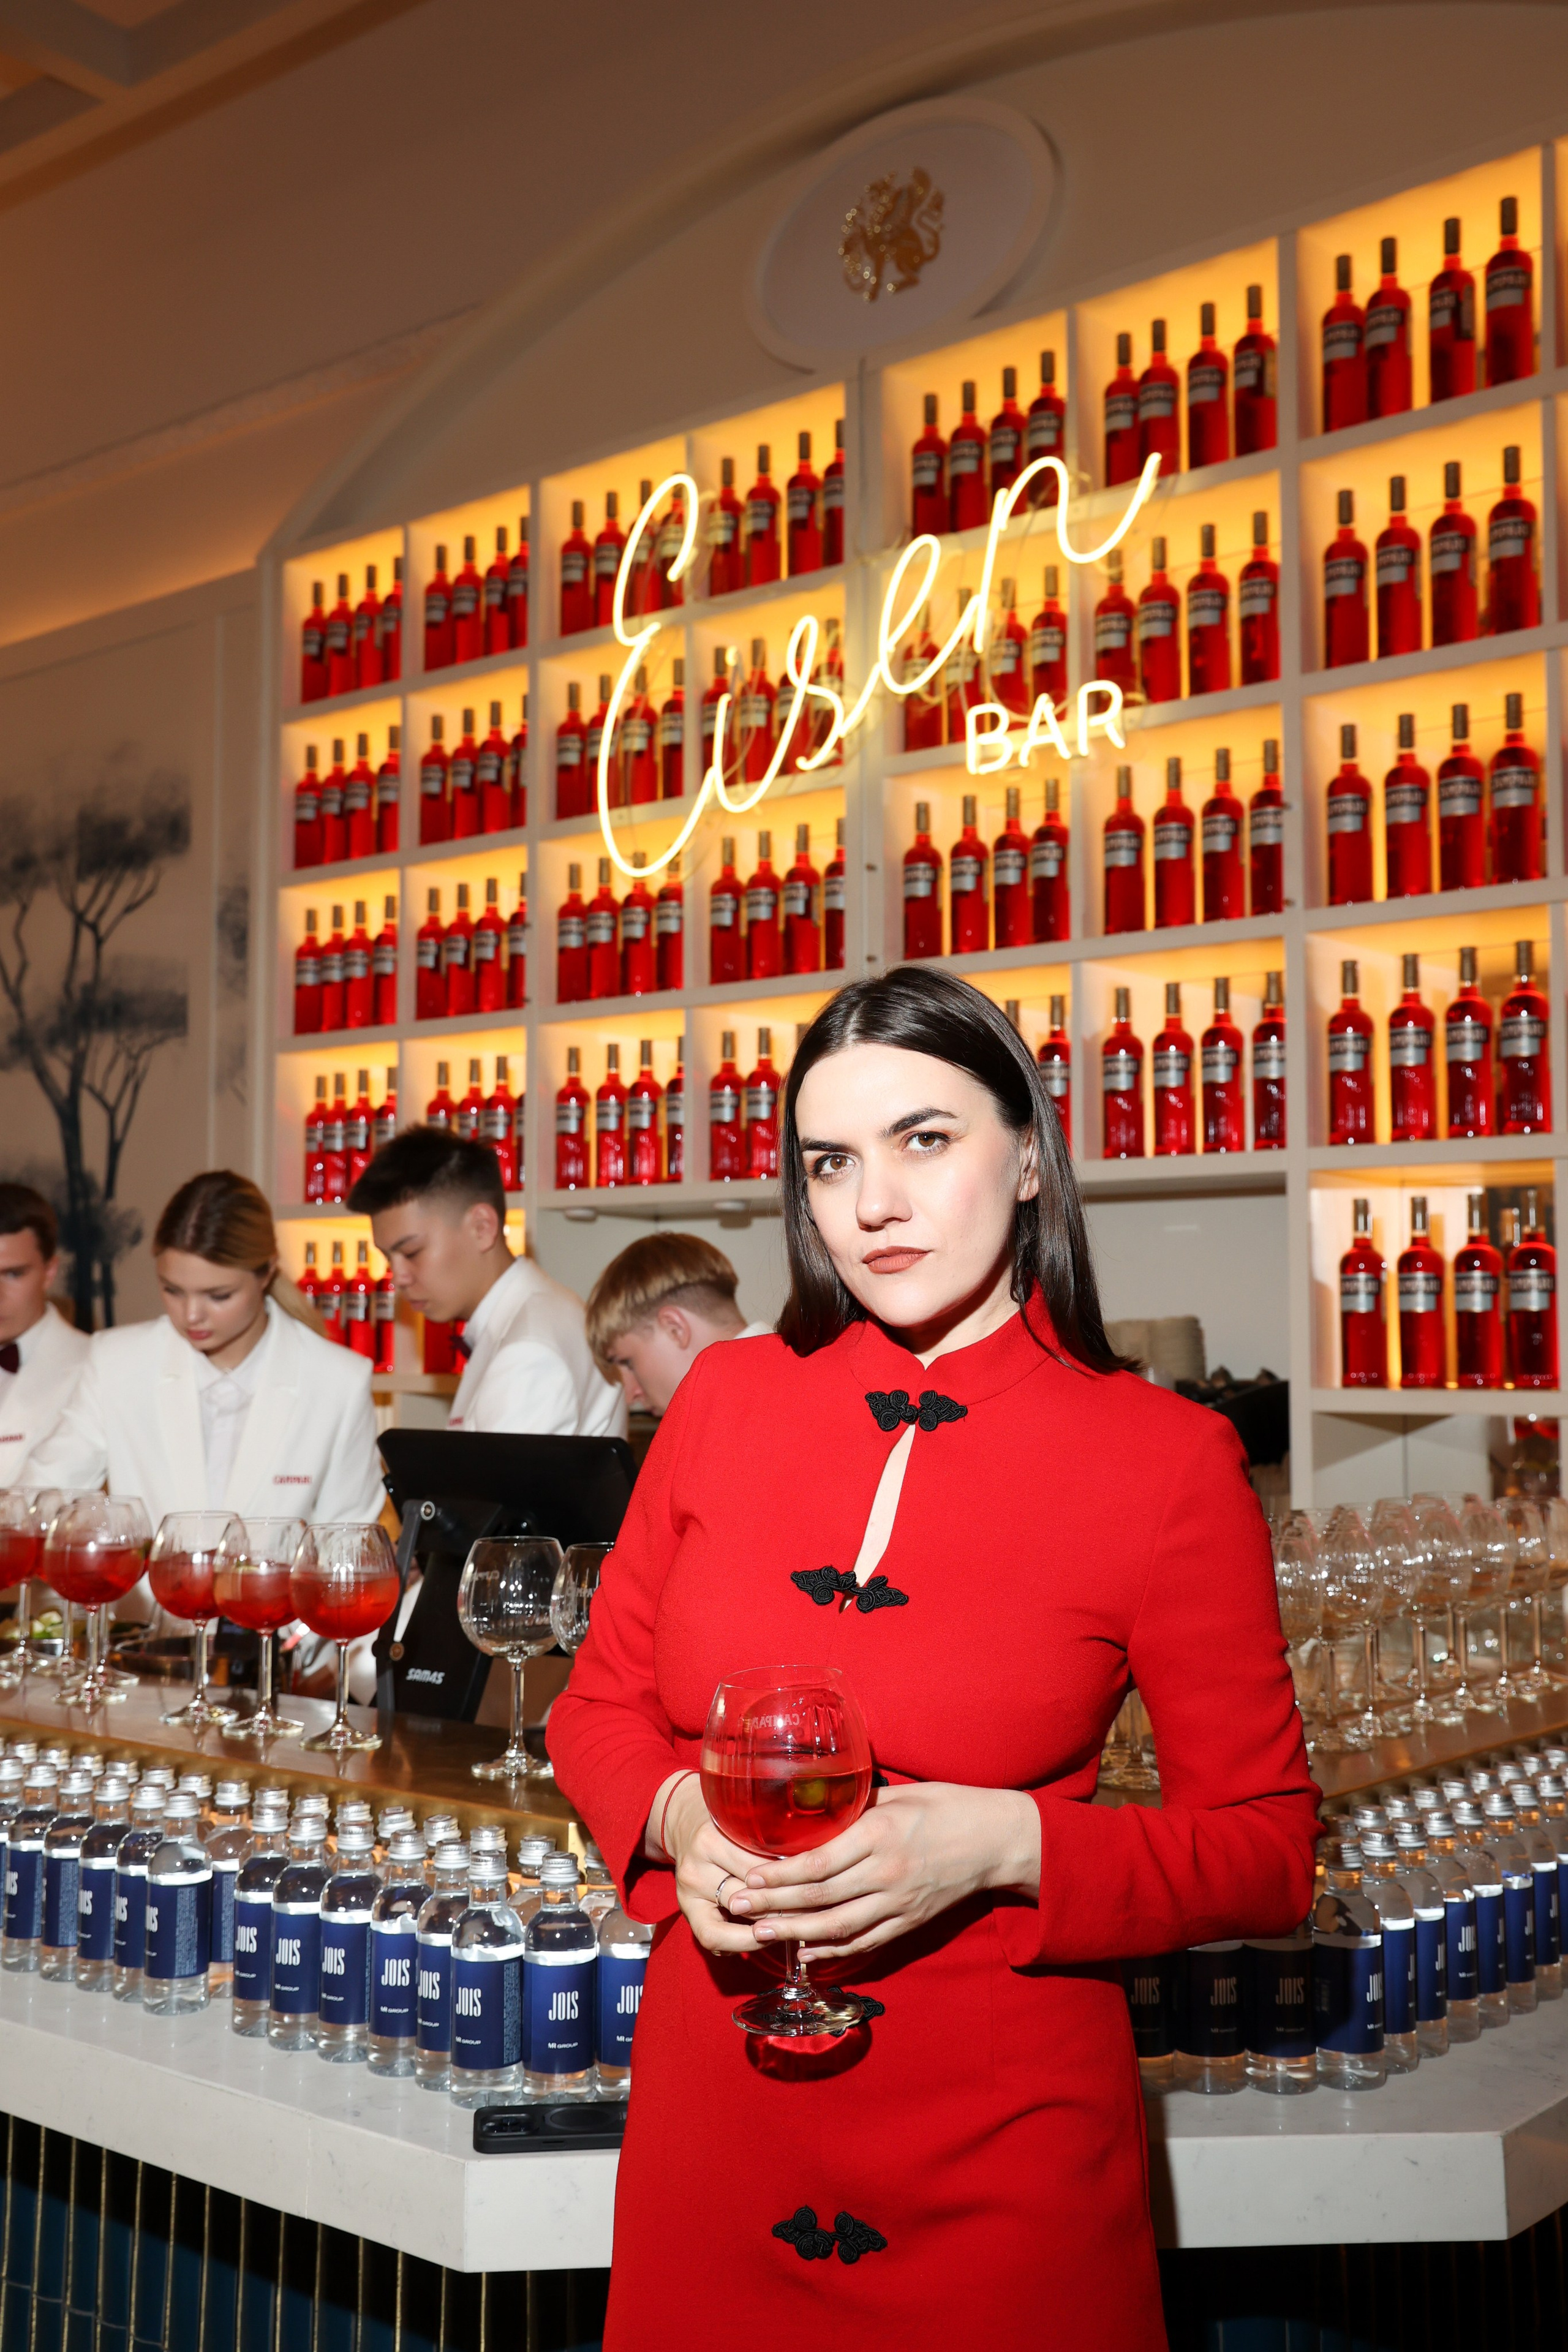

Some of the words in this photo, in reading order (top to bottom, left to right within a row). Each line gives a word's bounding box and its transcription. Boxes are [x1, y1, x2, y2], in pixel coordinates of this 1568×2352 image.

[966, 679, 1126, 774] BAR
[235, 1925, 257, 1953] JOIS
[276, 1937, 301, 1966] JOIS
[322, 1946, 345, 1975] JOIS
[381, 1958, 410, 1987] JOIS
[418, 1969, 440, 2000] JOIS
[1131, 1976, 1160, 2005] JOIS
[1210, 1976, 1237, 2006] JOIS
[1275, 1977, 1305, 2005] JOIS
[456, 1986, 481, 2017] JOIS
[548, 1990, 579, 2021] JOIS
